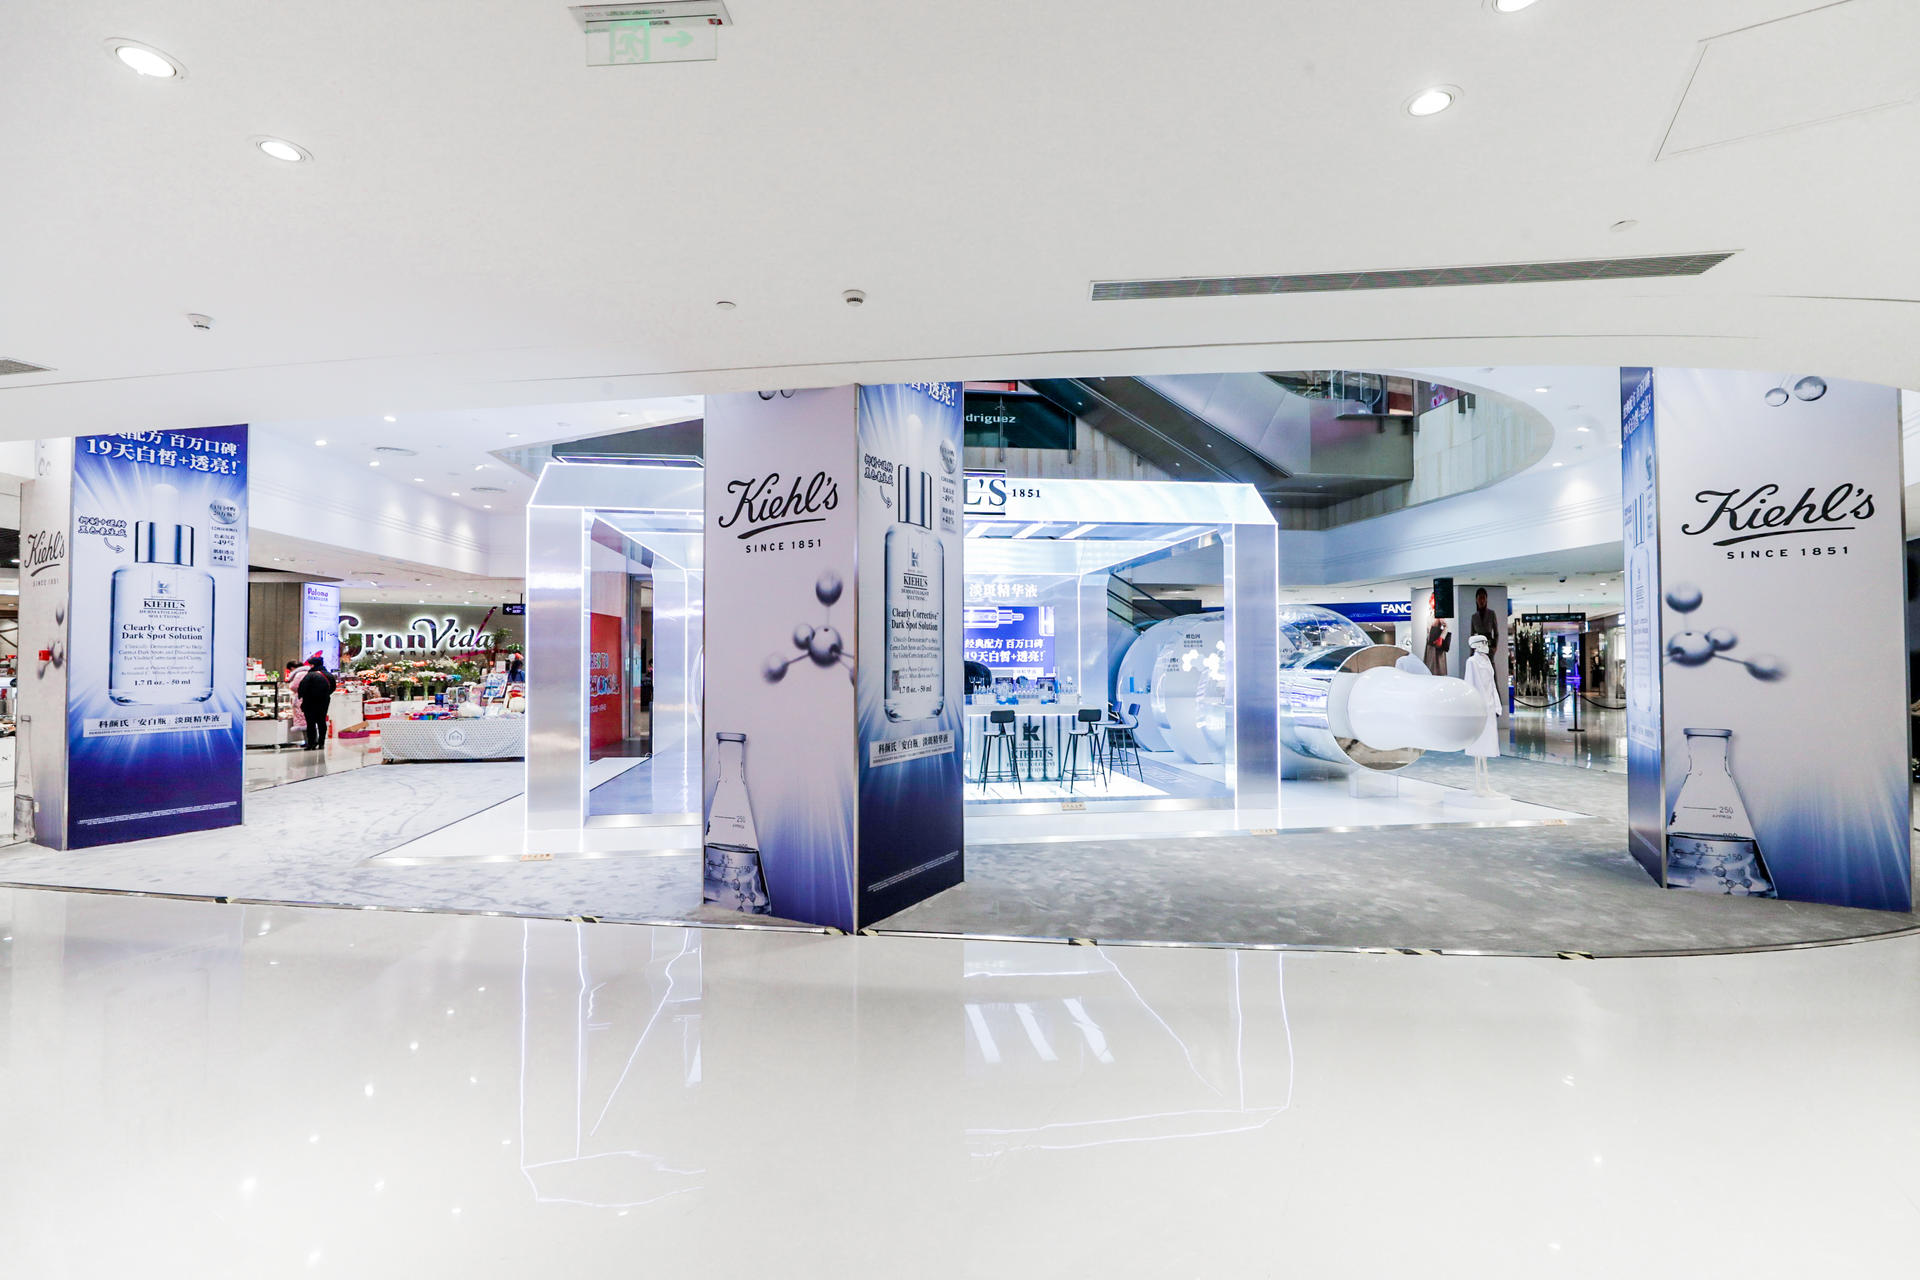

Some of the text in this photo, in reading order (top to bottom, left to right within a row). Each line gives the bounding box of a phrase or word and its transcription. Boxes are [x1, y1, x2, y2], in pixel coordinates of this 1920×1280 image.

[963, 413, 1016, 425] driguez
[169, 433, 238, 457] 百万口碑
[1012, 489, 1041, 497] 1851
[718, 471, 838, 528] Kiehl's
[1682, 483, 1875, 535] Kiehl's
[24, 530, 65, 568] Kiehl's
[746, 539, 822, 553] SINCE 1851
[1727, 546, 1849, 560] SINCE 1851
[903, 575, 928, 587] KIEHL'S
[143, 600, 186, 609] KIEHL'S
[892, 607, 911, 620] Clearly
[123, 624, 156, 634] Clearly
[891, 619, 938, 631] Dark Spot Solution
[121, 632, 203, 641] Dark Spot Solution
[399, 650, 446, 658] enjoy
[1719, 806, 1734, 814] 250
